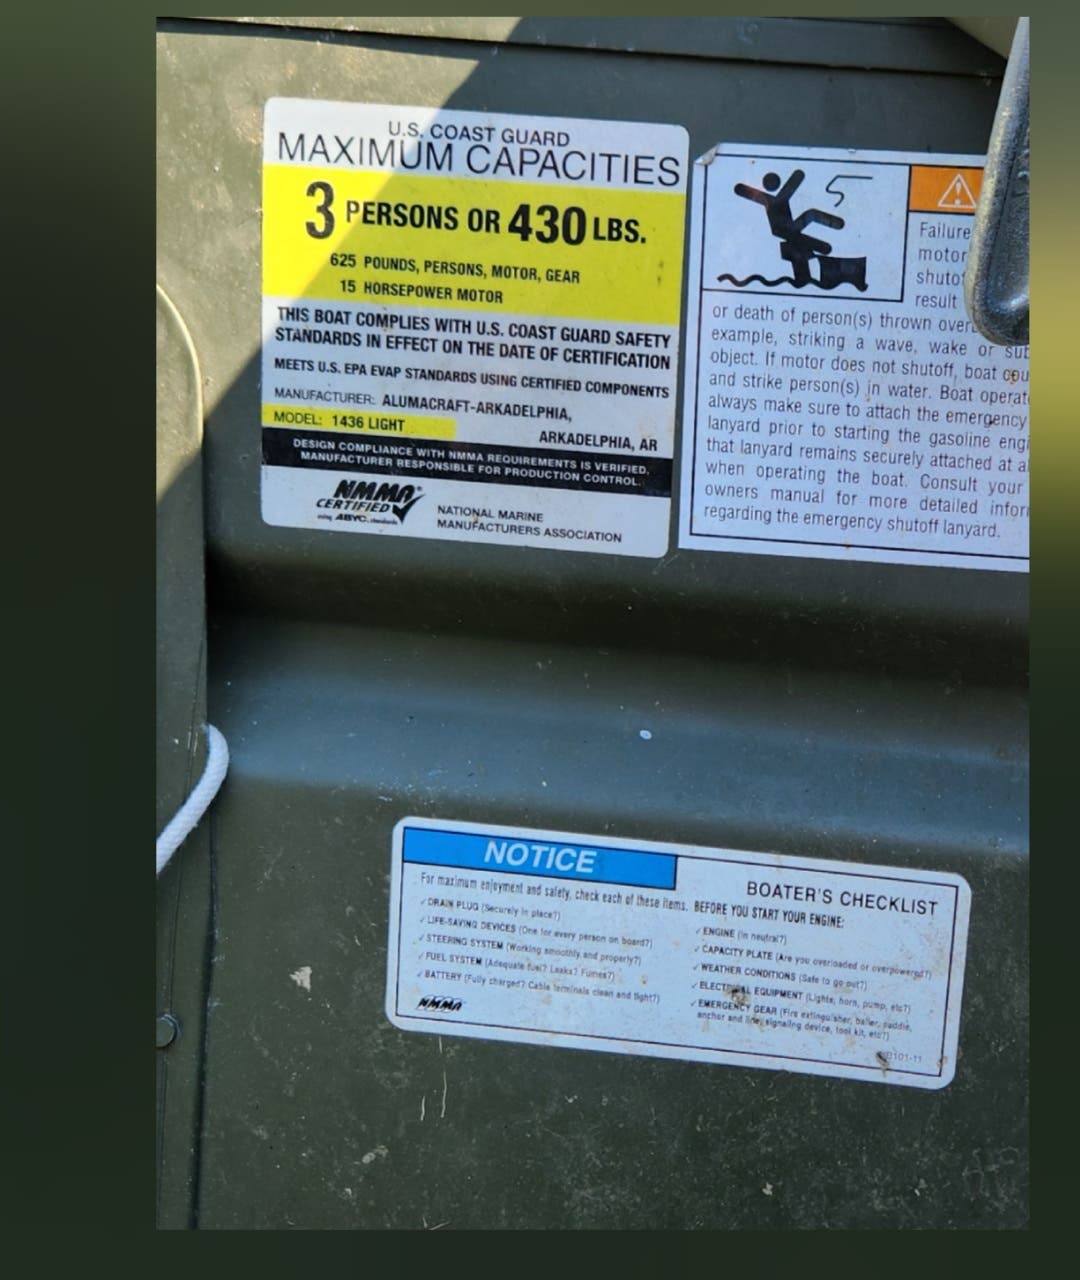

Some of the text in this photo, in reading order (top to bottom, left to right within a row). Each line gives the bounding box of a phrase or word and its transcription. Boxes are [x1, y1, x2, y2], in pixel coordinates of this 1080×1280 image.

[389, 121, 569, 146] U.S. COAST GUARD
[279, 132, 680, 186] MAXIMUM CAPACITIES
[305, 181, 646, 245] 3 PERSONS OR 430 LBS.
[920, 222, 970, 240] Failure
[330, 253, 580, 283] 625 POUNDS, PERSONS, MOTOR, GEAR
[918, 248, 967, 263] motor
[341, 280, 502, 304] 15 HORSEPOWER MOTOR
[915, 292, 956, 310] result
[278, 307, 670, 349] THIS BOAT COMPLIES WITH U.S. COAST GUARD SAFETY
[713, 304, 932, 331] or death of person(s) thrown
[275, 328, 670, 370] STANDARDS IN EFFECT ON THE DATE OF CERTIFICATION
[274, 358, 669, 399] MEETS U.S. EPA EVAP STANDARDS USING CERTIFIED COMPONENTS
[709, 372, 972, 402] and strike person(s) in water. Boat
[274, 387, 572, 422] MANUFACTURER: ALUMACRAFT-ARKADELPHIA,
[708, 394, 1027, 431] always make sure to attach the emergency
[274, 411, 405, 432] MODEL: 1436 LIGHT
[708, 415, 990, 448] lanyard prior to starting the gasoline
[293, 438, 335, 450] DESIGN
[338, 442, 412, 456] COMPLIANCE
[417, 448, 444, 458] WITH
[449, 450, 484, 461] NMMA
[488, 454, 577, 469] REQUIREMENTS
[580, 461, 591, 470] IS
[539, 430, 658, 452] ARKADELPHIA, AR
[707, 437, 1013, 472] that lanyard remains securely attached at
[301, 451, 641, 486] MANUFACTURER RESPONSIBLE FOR PRODUCTION CONTROL.
[706, 461, 1023, 496] when operating the boat. Consult your
[316, 498, 390, 513] CERTIFIED
[437, 505, 543, 522] NATIONAL MARINE
[705, 484, 978, 514] owners manual for more detailed
[437, 519, 622, 543] MANUFACTURERS ASSOCIATION
[704, 505, 1001, 540] regarding the emergency shutoff lanyard.
[484, 840, 598, 873] NOTICE
[421, 872, 435, 885] For
[438, 875, 477, 889] maximum
[481, 878, 523, 896] enjoyment
[526, 881, 542, 895] and
[575, 885, 599, 902] check
[602, 890, 622, 904] each
[626, 892, 635, 905] of
[636, 894, 659, 908] these
[694, 901, 727, 915] BEFORE
[731, 905, 748, 917] YOU
[752, 907, 779, 921] START
[783, 911, 806, 923] YOUR
[810, 913, 844, 928] ENGINE:
[747, 881, 938, 916] BOATER'S CHECKLIST
